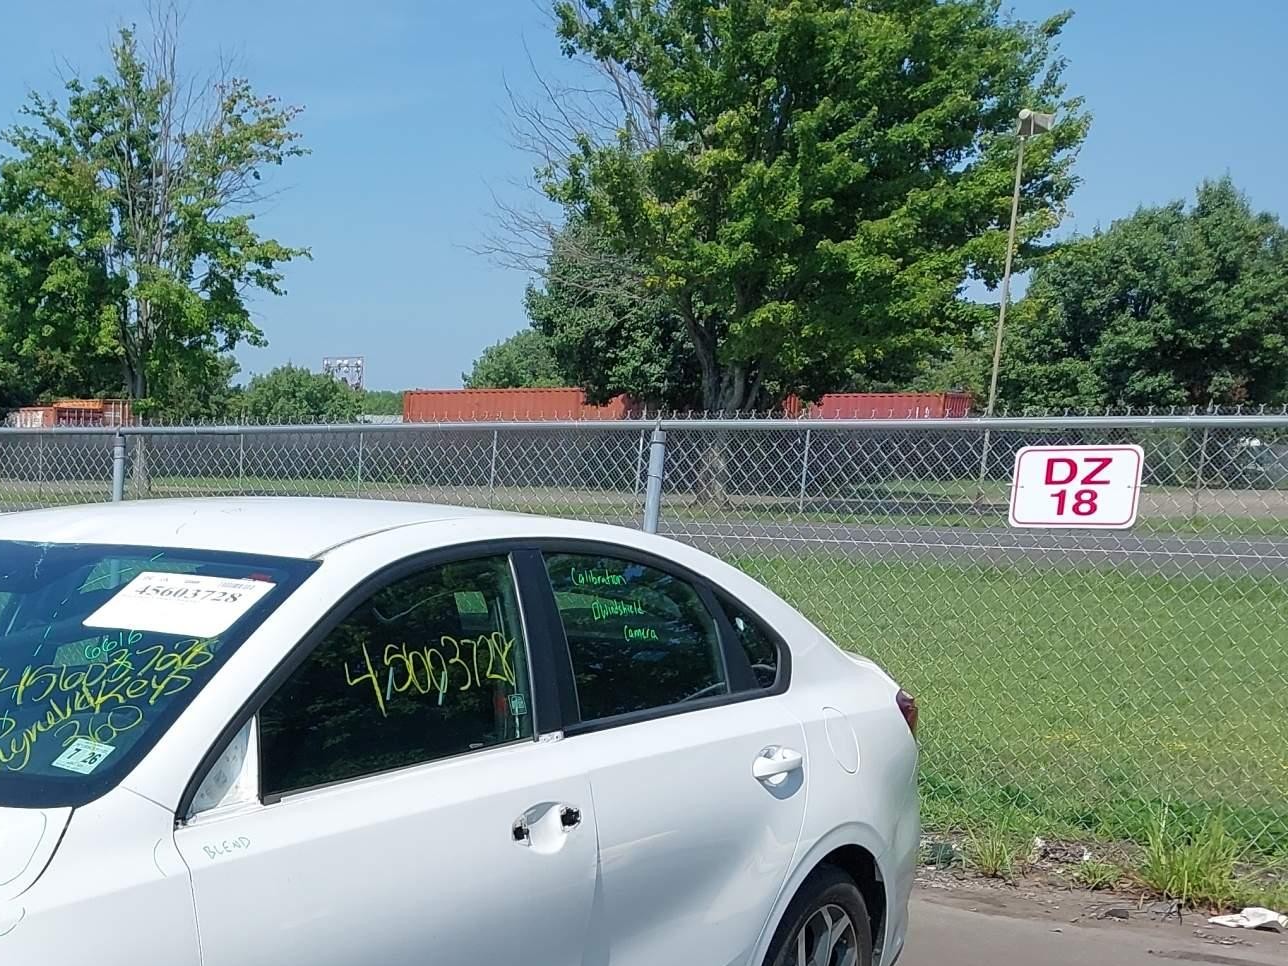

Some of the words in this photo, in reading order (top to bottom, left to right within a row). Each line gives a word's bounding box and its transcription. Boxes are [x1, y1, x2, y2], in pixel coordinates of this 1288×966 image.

[1044, 457, 1113, 486] DZ
[1050, 489, 1098, 516] 18
[571, 567, 627, 586] Calibration
[135, 584, 243, 603] 45603728
[623, 625, 659, 641] Camera
[67, 747, 82, 760] 7
[80, 751, 102, 765] 26
[202, 836, 251, 860] BLEND
